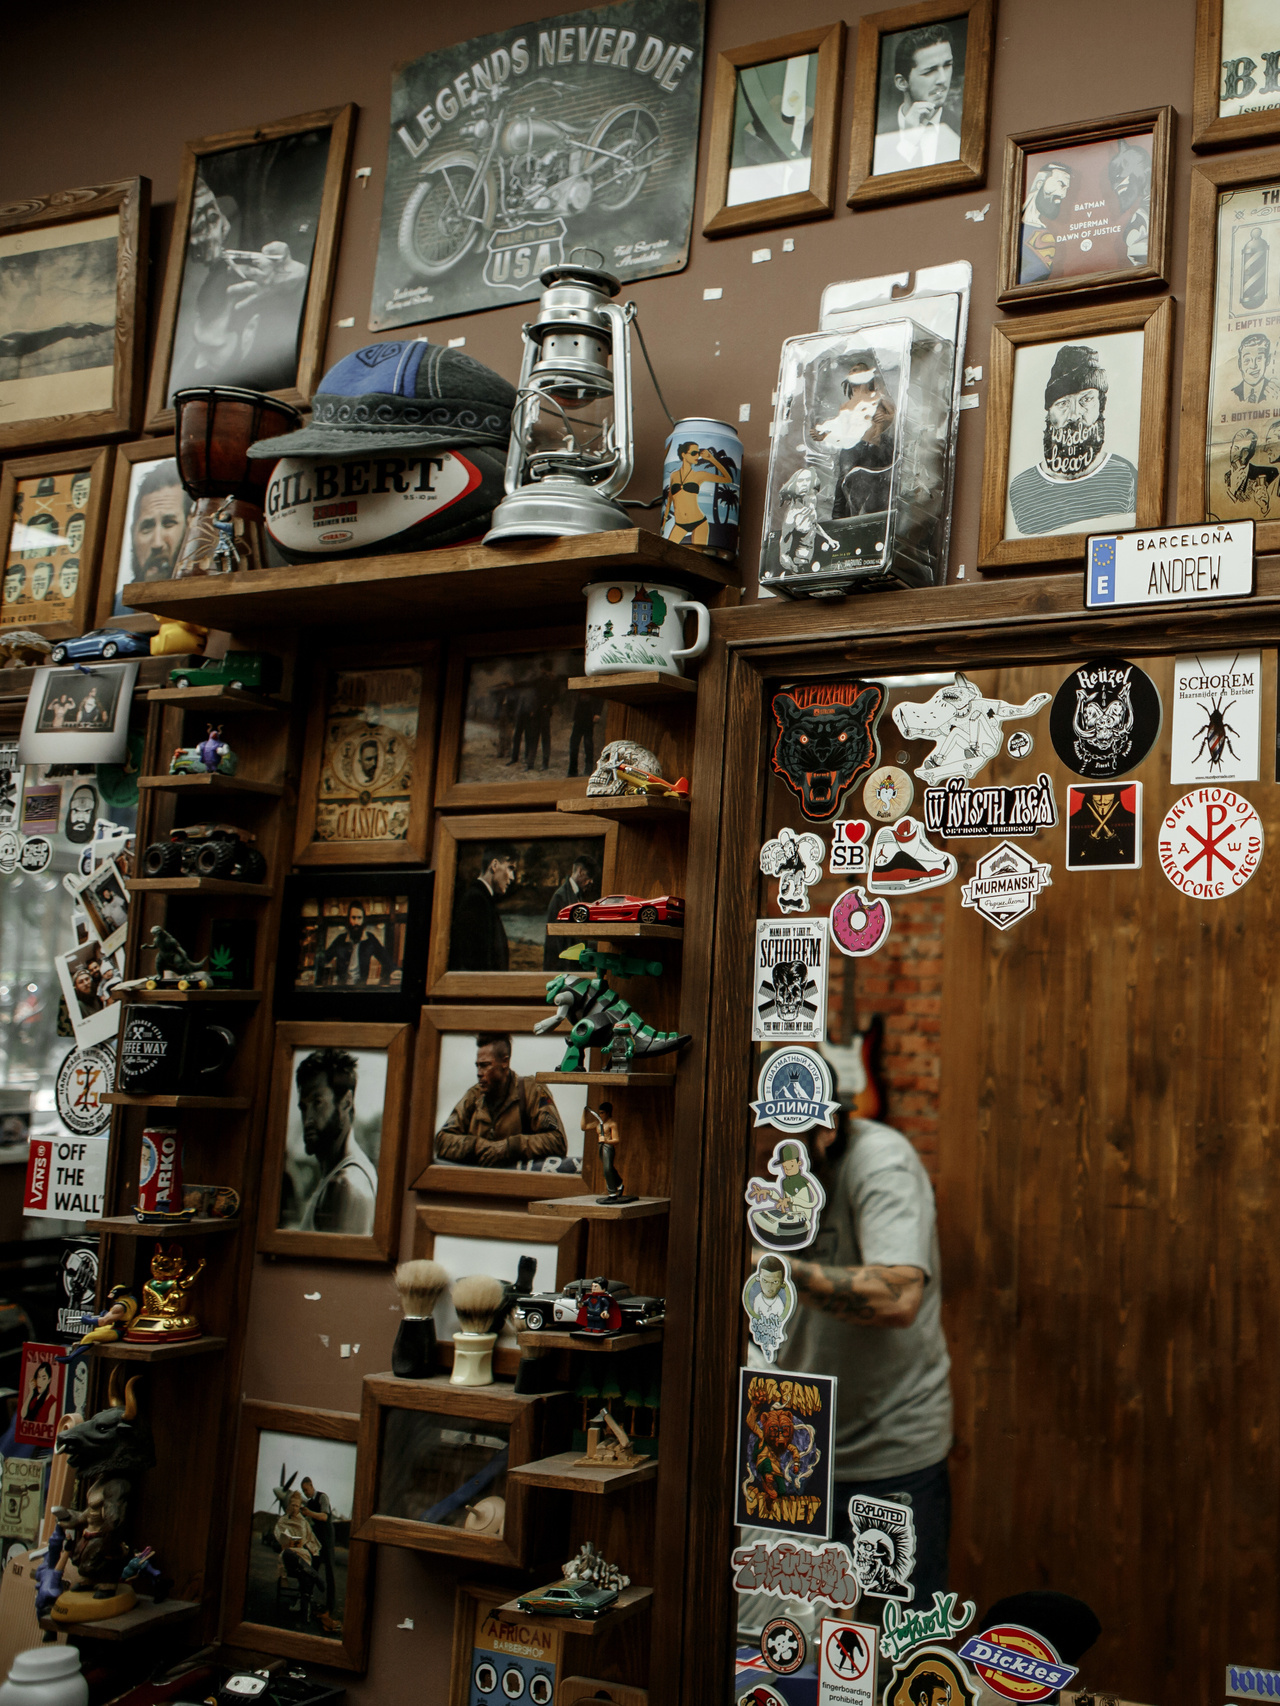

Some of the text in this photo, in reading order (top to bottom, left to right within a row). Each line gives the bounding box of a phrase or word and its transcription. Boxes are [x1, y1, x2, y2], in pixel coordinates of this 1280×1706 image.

[397, 27, 694, 158] LEGENDS NEVER DIE
[1074, 200, 1105, 211] BATMAN
[1056, 225, 1121, 243] DAWN OF JUSTICE
[1069, 218, 1109, 231] SUPERMAN
[492, 243, 551, 283] USA
[1228, 323, 1233, 332] 1.
[1235, 318, 1263, 331] EMPTY
[1221, 414, 1229, 423] 3.
[1231, 409, 1271, 423] BOTTOMS
[267, 457, 443, 516] GILBERT
[341, 515, 358, 524] BALL
[1136, 531, 1233, 551] BARCELONA
[1147, 556, 1221, 595] ANDREW
[1097, 576, 1109, 595] E
[1077, 665, 1134, 689] Reüzel
[1179, 673, 1255, 691] SCHOREM
[1179, 690, 1217, 699] Haarsnijder
[1230, 688, 1254, 697] Barbier
[1165, 789, 1257, 830] ORTHODOX
[337, 808, 388, 839] CLASSICS
[834, 823, 845, 843] I
[945, 826, 988, 835] ORTHODOX
[833, 845, 864, 867] SB
[1232, 836, 1261, 887] CREW
[1159, 841, 1225, 898] HARDCORE
[975, 875, 1036, 896] MURMANSK
[769, 928, 782, 937] MAMA
[796, 927, 805, 936] LIKE
[760, 938, 822, 968] SCHOREM
[796, 1022, 802, 1031] MY
[143, 1042, 168, 1054] WAY
[767, 1055, 820, 1083] ШАХМАТНЫЙ КЛУБ
[765, 1102, 820, 1117] ОЛИМП
[57, 1167, 85, 1186] THE
[155, 1137, 177, 1202] ARKO
[30, 1157, 47, 1204] VANS
[20, 1421, 54, 1440] GRAPE
[4, 1461, 41, 1479] SCHOREM
[745, 1486, 822, 1525] PLANET
[487, 1621, 551, 1649] AFRICAN
[493, 1640, 545, 1659] BARBERSHOP
[969, 1643, 1063, 1685] Dickies
[822, 1682, 872, 1699] fingerboarding
[828, 1693, 864, 1706] prohibited
